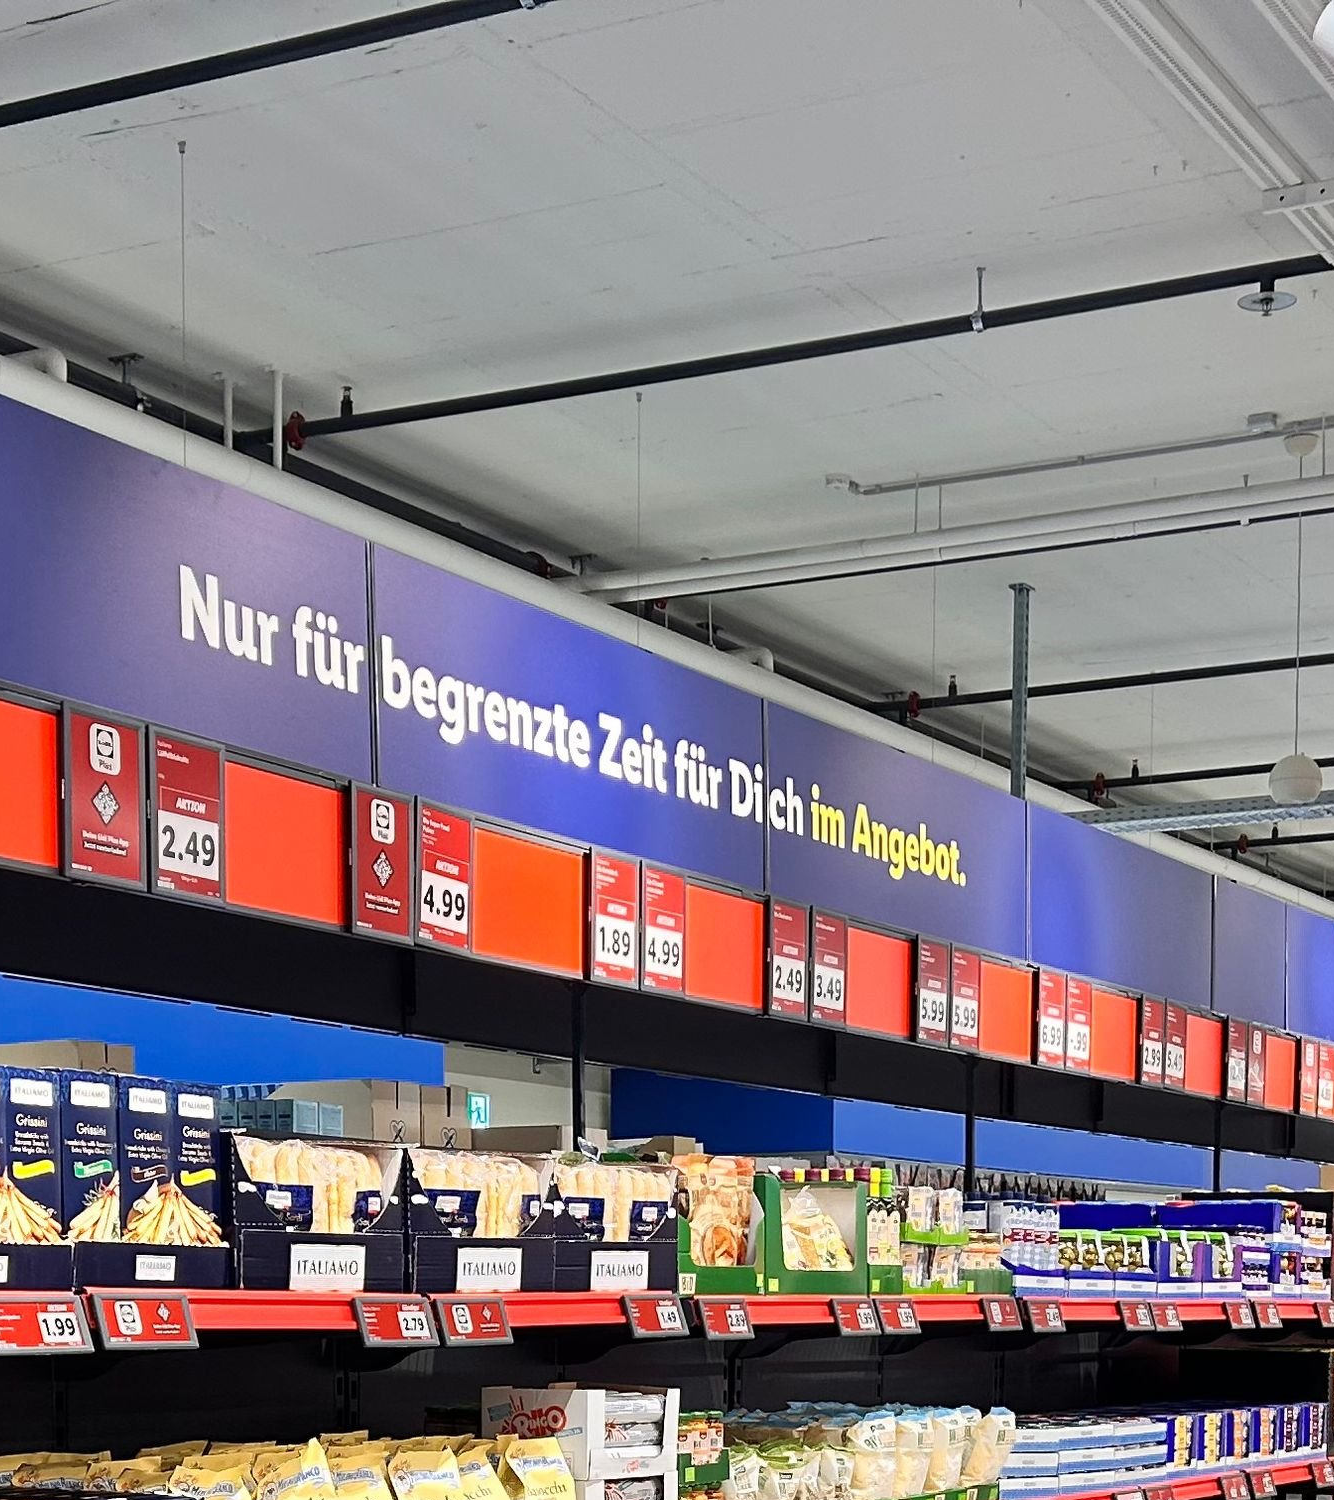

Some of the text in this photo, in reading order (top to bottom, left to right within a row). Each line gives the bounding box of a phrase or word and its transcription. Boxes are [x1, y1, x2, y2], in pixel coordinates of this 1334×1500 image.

[179, 563, 969, 887] Nur für begrenzte Zeit für Dich im Angebot.
[162, 825, 216, 867] 2.49
[424, 884, 466, 921] 4.99
[599, 927, 631, 957] 1.89
[647, 937, 680, 967] 4.99
[774, 965, 803, 994] 2.49
[816, 973, 843, 1001] 3.49
[921, 997, 944, 1022] 5.99
[953, 1004, 977, 1029] 5.99
[1042, 1024, 1063, 1044] 6.99
[15, 1113, 49, 1129] Grissini
[297, 1260, 359, 1279] ITALIAMO
[462, 1262, 516, 1279] ITALIAMO
[42, 1317, 76, 1339] 1.99
[401, 1317, 424, 1333] 2.79
[660, 1311, 677, 1325] 1.49
